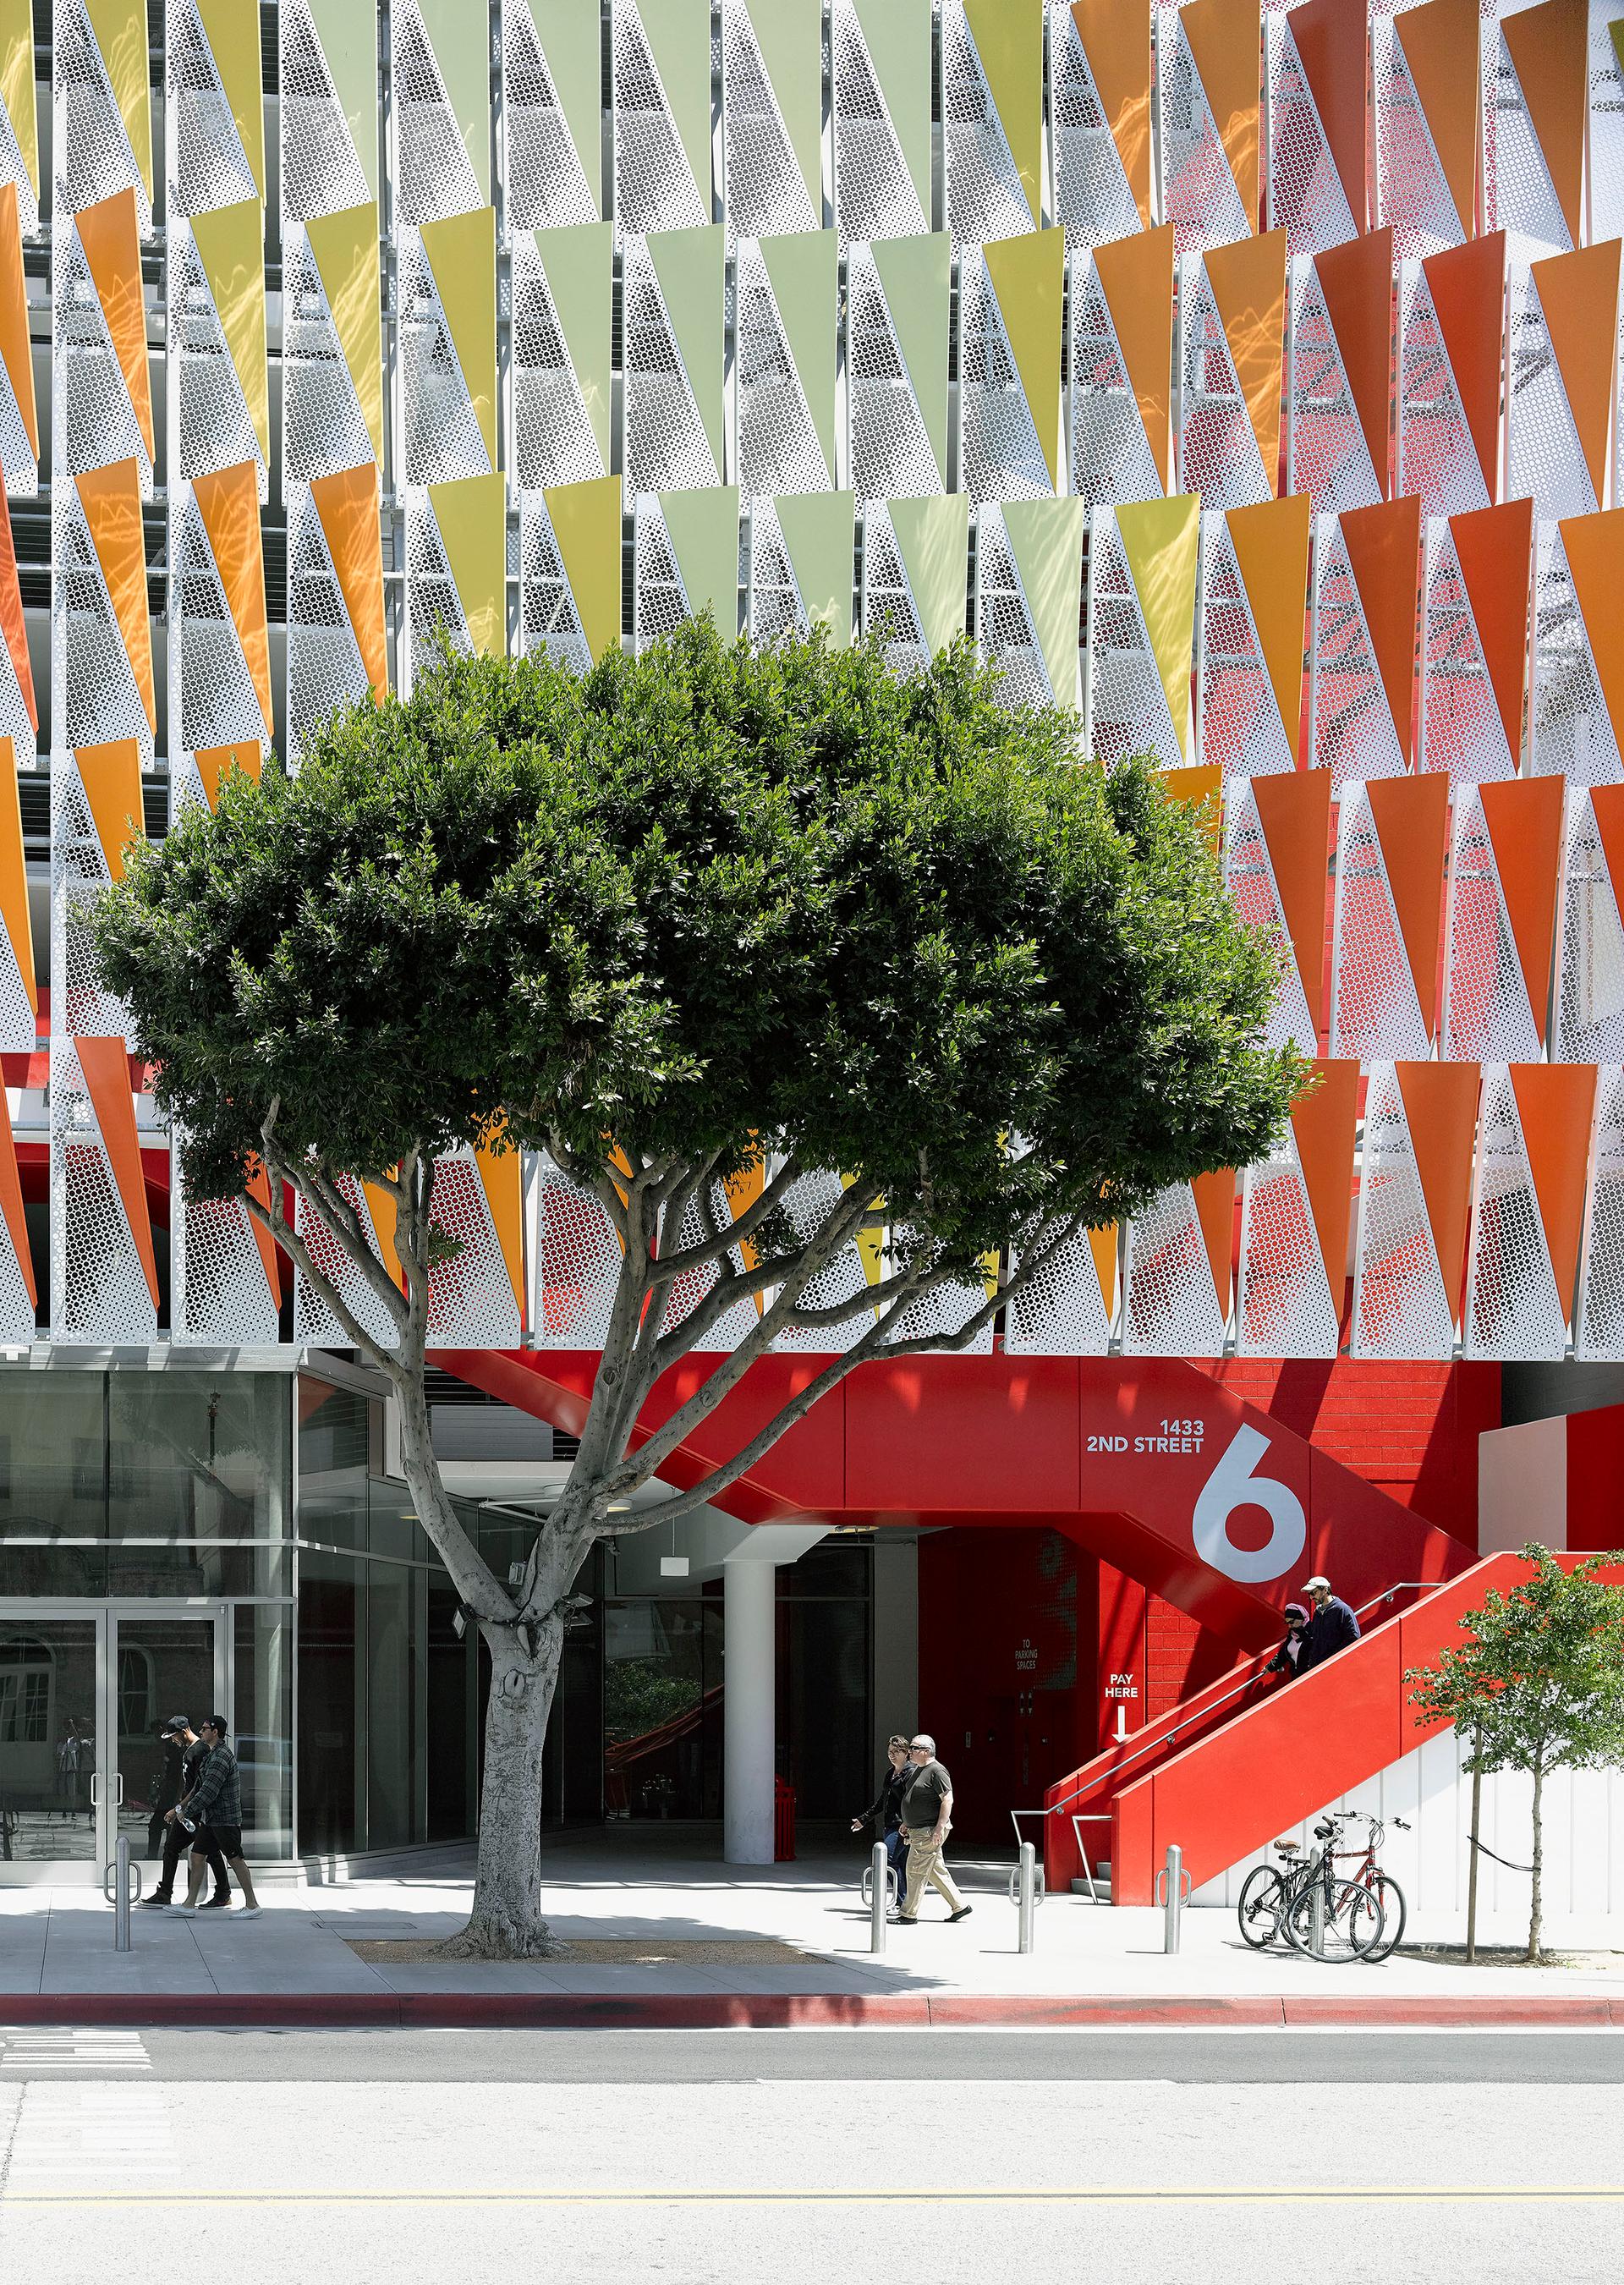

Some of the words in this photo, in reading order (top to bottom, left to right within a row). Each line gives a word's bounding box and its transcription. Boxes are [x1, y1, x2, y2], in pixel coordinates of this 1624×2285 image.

[1160, 1420, 1204, 1436] 1433
[1086, 1436, 1128, 1452] 2ND
[1133, 1436, 1204, 1453] STREET
[1192, 1421, 1307, 1584] 6
[1022, 1639, 1030, 1649] TO
[1015, 1649, 1038, 1659] PARKING
[1017, 1660, 1036, 1670] SPACES
[1110, 1674, 1133, 1684] PAY
[1105, 1687, 1138, 1698] HERE
